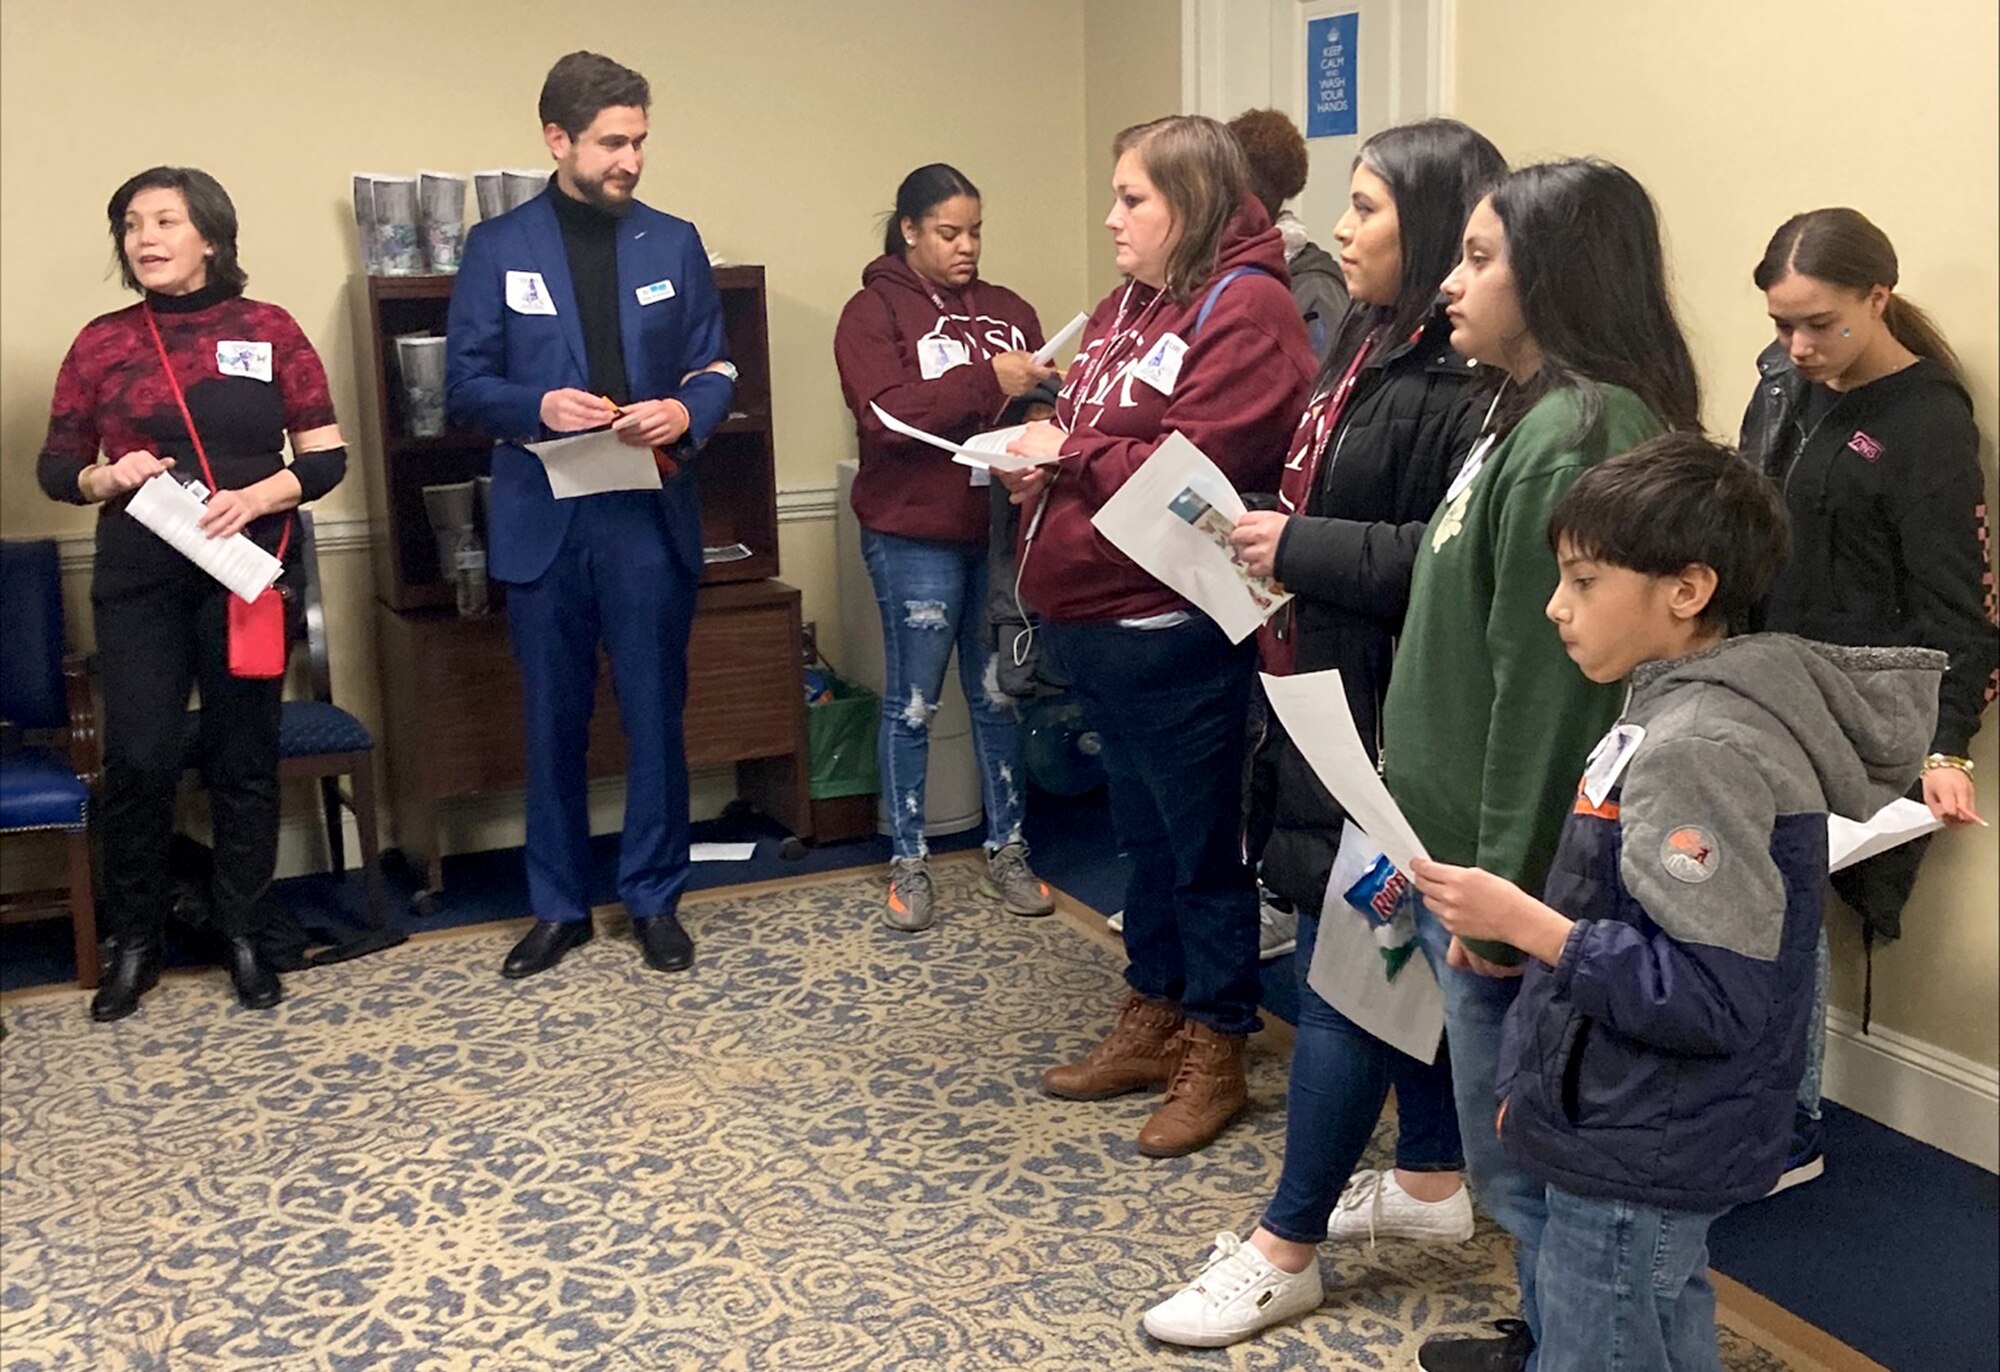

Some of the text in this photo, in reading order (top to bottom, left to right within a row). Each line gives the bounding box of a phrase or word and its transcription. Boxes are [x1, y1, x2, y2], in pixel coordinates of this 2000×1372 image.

[1323, 45, 1343, 57] KEEP
[1321, 58, 1344, 70] CALM
[1319, 77, 1346, 90] WASH
[1321, 88, 1345, 101] YOUR
[1317, 100, 1348, 113] HANDS
